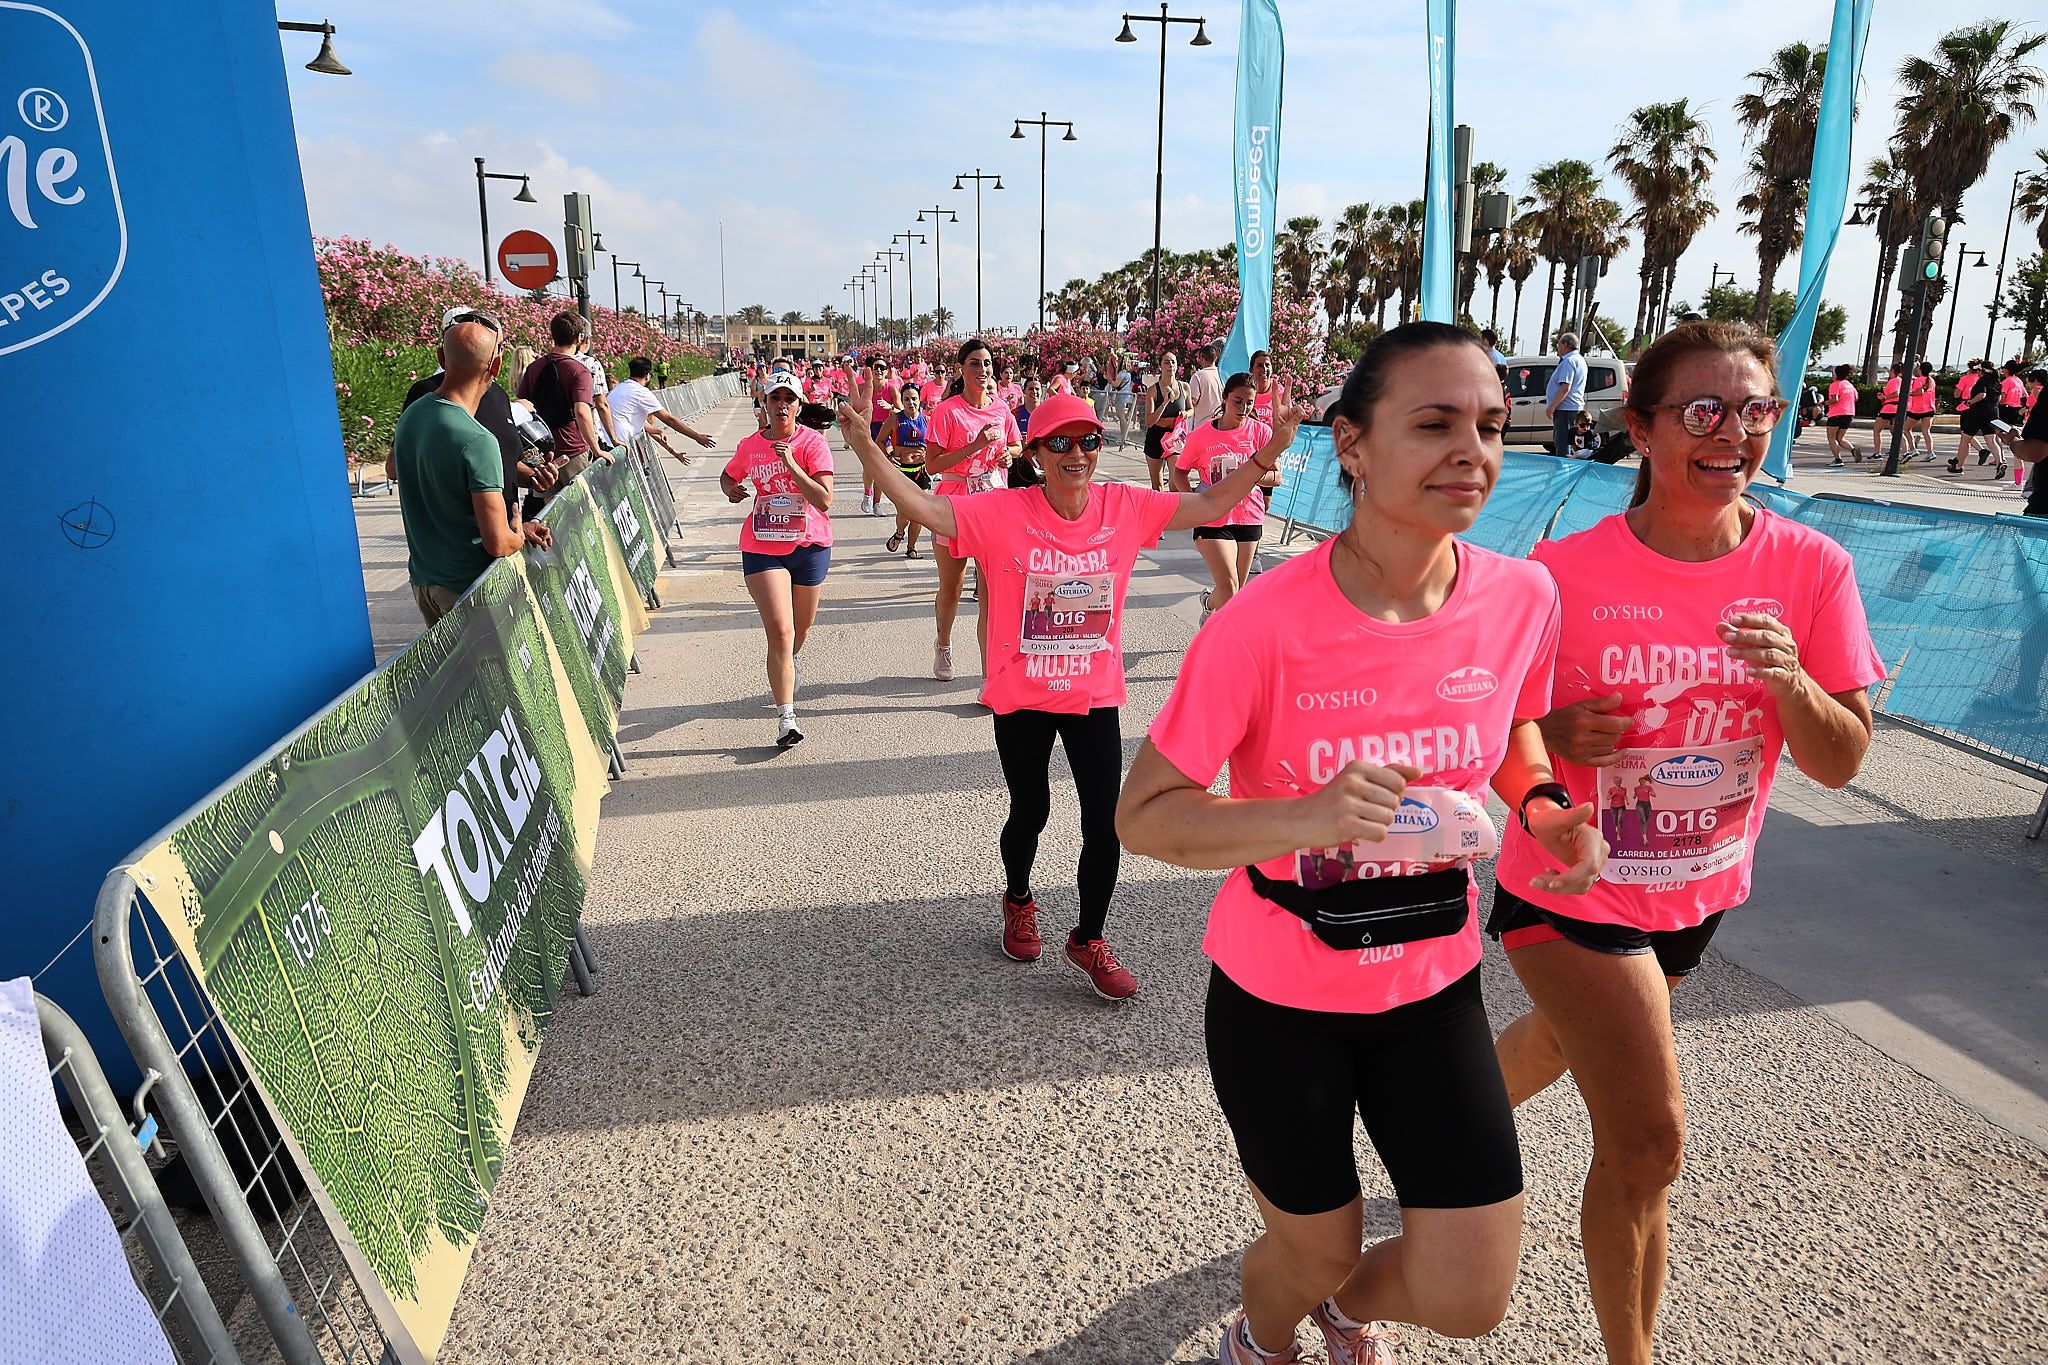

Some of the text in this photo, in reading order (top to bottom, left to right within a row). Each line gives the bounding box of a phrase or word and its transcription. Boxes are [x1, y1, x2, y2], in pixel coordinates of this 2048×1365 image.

[776, 375, 793, 386] LA
[769, 514, 790, 523] 016
[1029, 547, 1109, 574] CARRERA
[1056, 587, 1090, 595] ASTURIANA
[1053, 611, 1086, 626] 016
[1593, 605, 1663, 621] OYSHO
[1031, 643, 1060, 651] OYSHO
[1025, 654, 1091, 678] MUJER
[1600, 644, 1760, 686] CARRER
[1047, 679, 1072, 691] 2026
[1443, 681, 1494, 697] ASTURIANA
[1296, 688, 1378, 711] OYSHO
[1307, 722, 1483, 785] CARRERA
[1614, 760, 1647, 769] SUMA
[1656, 767, 1719, 780] ASTURIANA
[1394, 814, 1433, 827] RIANA
[1656, 807, 1718, 834] 016
[1673, 835, 1702, 847] 2178
[1617, 849, 1656, 859] CARRERA
[1657, 850, 1669, 858] DE
[1670, 850, 1681, 858] LA
[1682, 846, 1709, 857] MUJER
[1357, 861, 1430, 880] 016
[1618, 865, 1672, 877] OYSHO
[284, 889, 332, 968] 1975
[469, 900, 522, 1013] Cuidando
[514, 877, 532, 918] de
